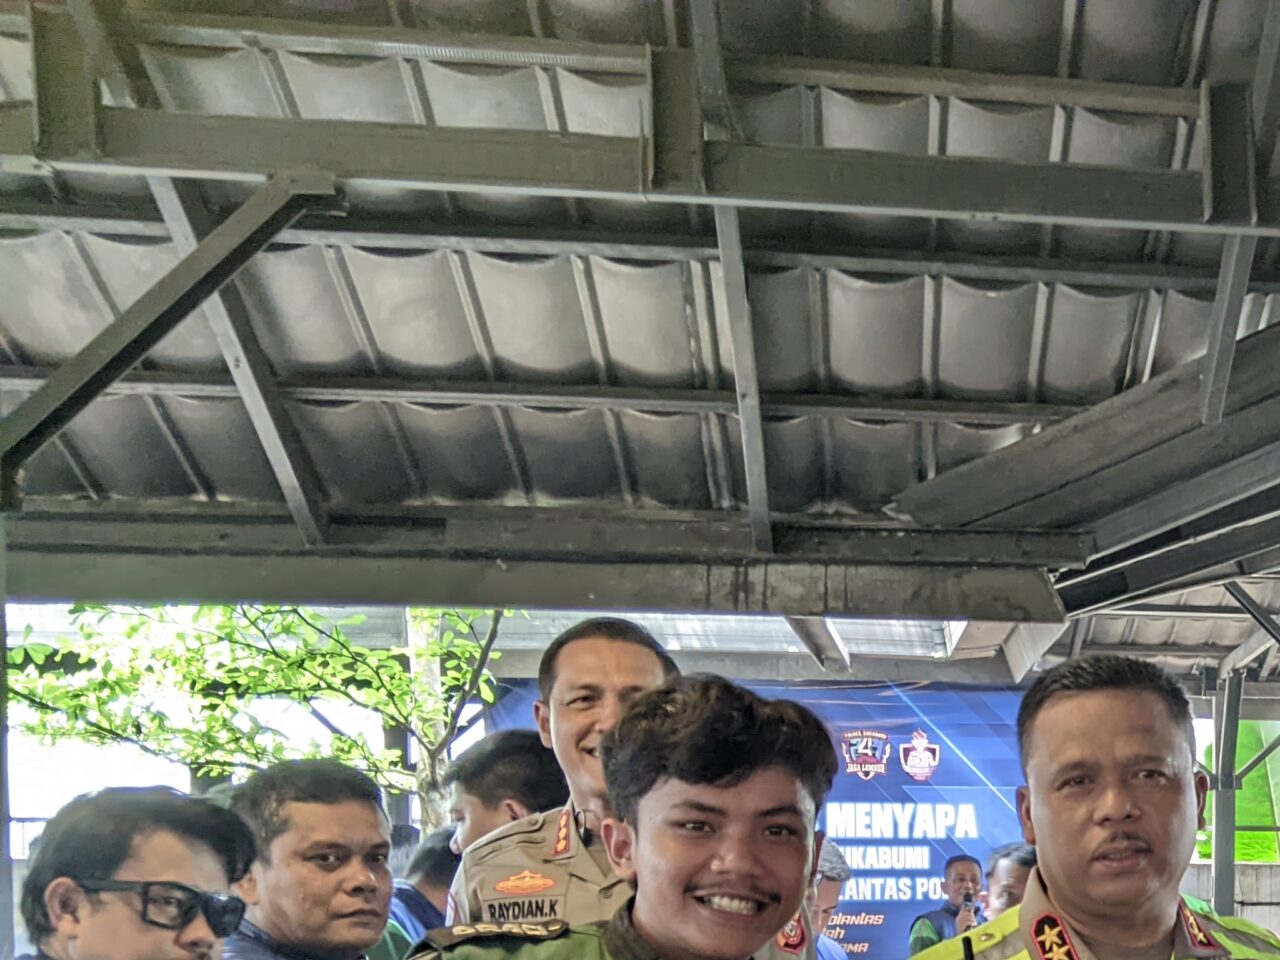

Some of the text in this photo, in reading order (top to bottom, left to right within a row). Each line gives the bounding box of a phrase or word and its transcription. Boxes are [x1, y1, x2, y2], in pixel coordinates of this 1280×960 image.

[826, 802, 978, 838] MENYAPA
[840, 846, 930, 869] UKABUMI
[839, 878, 911, 900] ANTAS
